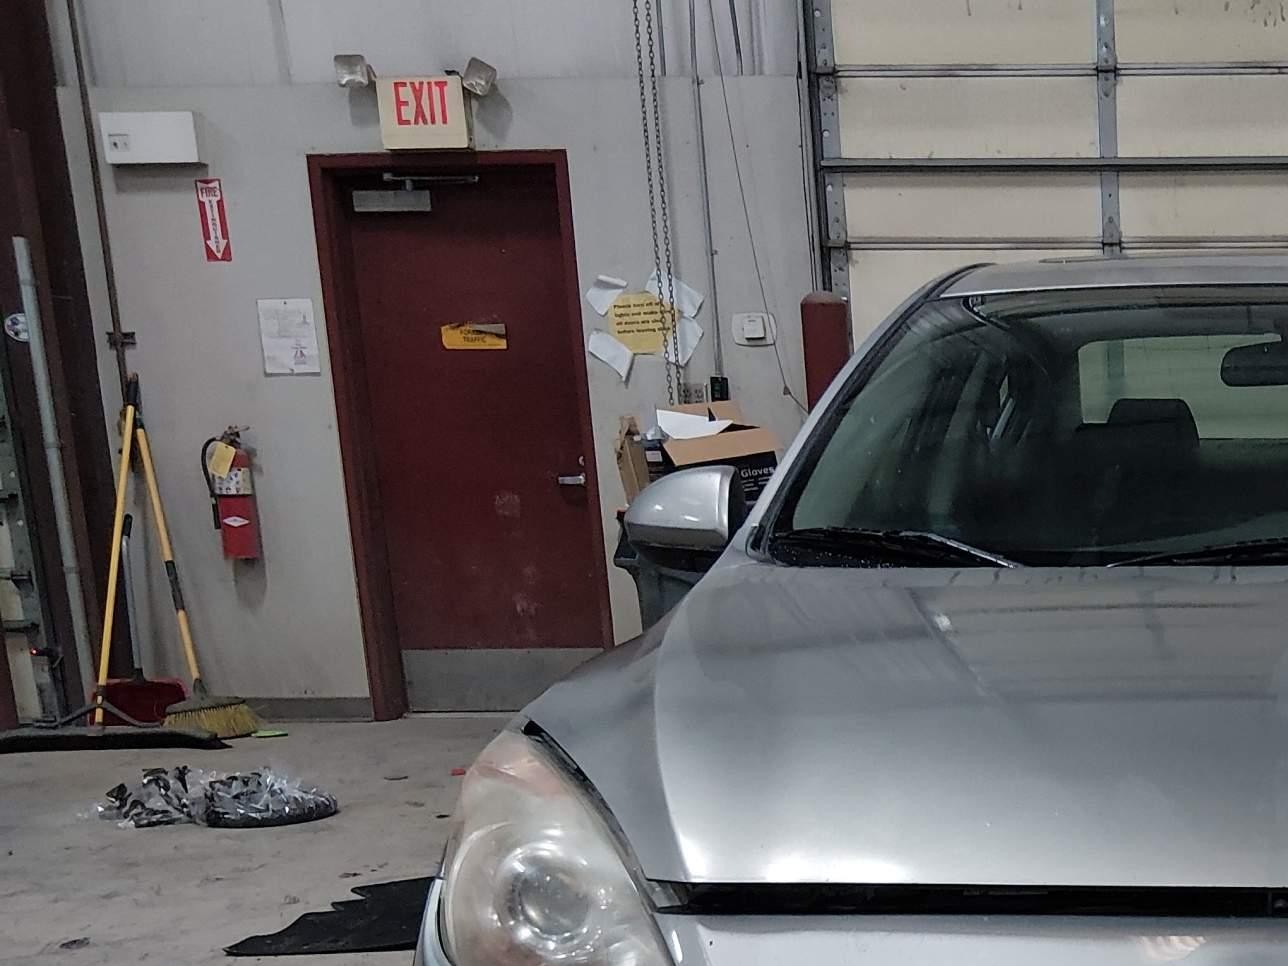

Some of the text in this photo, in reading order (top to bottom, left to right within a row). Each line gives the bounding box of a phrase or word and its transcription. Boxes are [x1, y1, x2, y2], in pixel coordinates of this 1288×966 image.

[393, 81, 448, 125] EXIT
[200, 186, 219, 197] FIRE
[740, 465, 776, 478] Gloves
